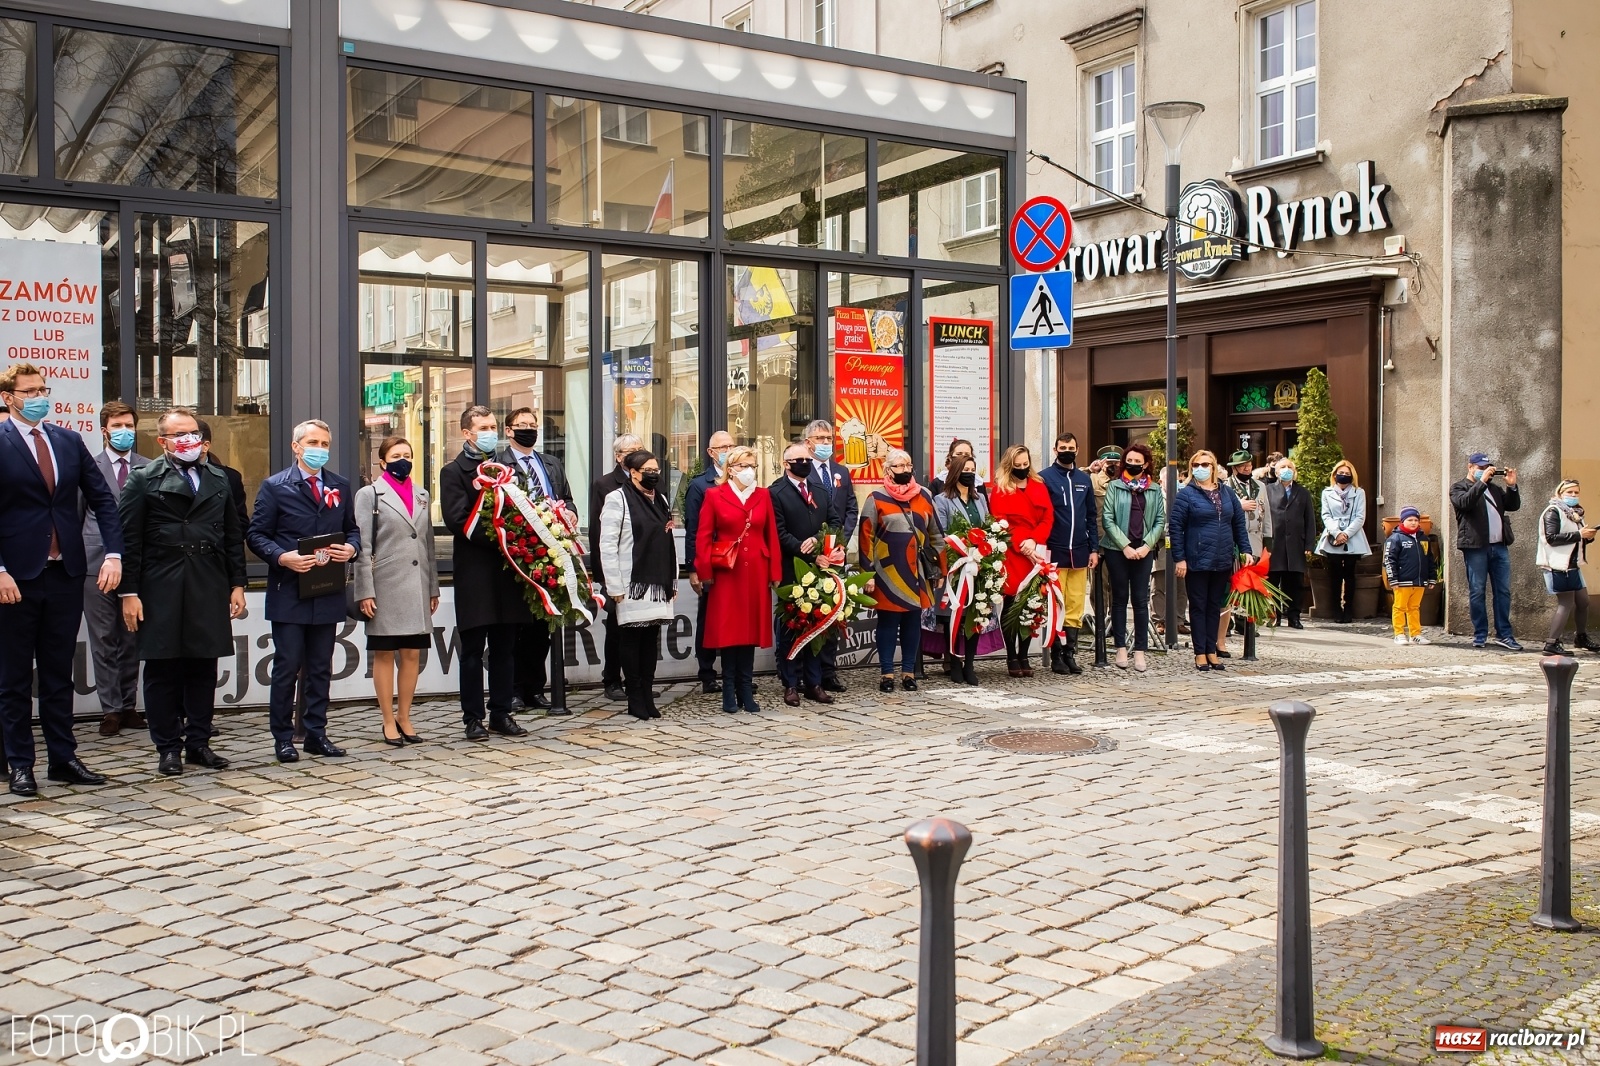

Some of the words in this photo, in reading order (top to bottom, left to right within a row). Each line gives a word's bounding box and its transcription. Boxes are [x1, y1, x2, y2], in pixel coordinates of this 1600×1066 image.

[1054, 230, 1163, 283] rowar
[1246, 160, 1388, 258] Rynek
[1175, 246, 1202, 264] rowar
[1204, 239, 1233, 259] Rynek
[0, 278, 98, 305] ZAMÓW
[2, 309, 10, 321] Z
[16, 310, 94, 325] DOWOZEM
[836, 310, 849, 319] Pizza
[851, 311, 865, 320] Time
[836, 322, 853, 334] Druga
[854, 323, 867, 334] pizza
[941, 324, 983, 339] LUNCH
[34, 329, 64, 341] LUB
[844, 334, 863, 346] gratis!
[8, 347, 89, 361] ODBIOREM
[39, 366, 89, 379] OKALU
[845, 356, 895, 377] Promocja
[853, 378, 869, 386] DWA
[870, 379, 887, 387] PIWA
[869, 388, 898, 396] JEDNEGO
[55, 403, 72, 414] 84
[77, 403, 94, 414] 84
[78, 421, 93, 431] 75
[846, 626, 877, 649] Ryne
[839, 653, 857, 665] 2013
